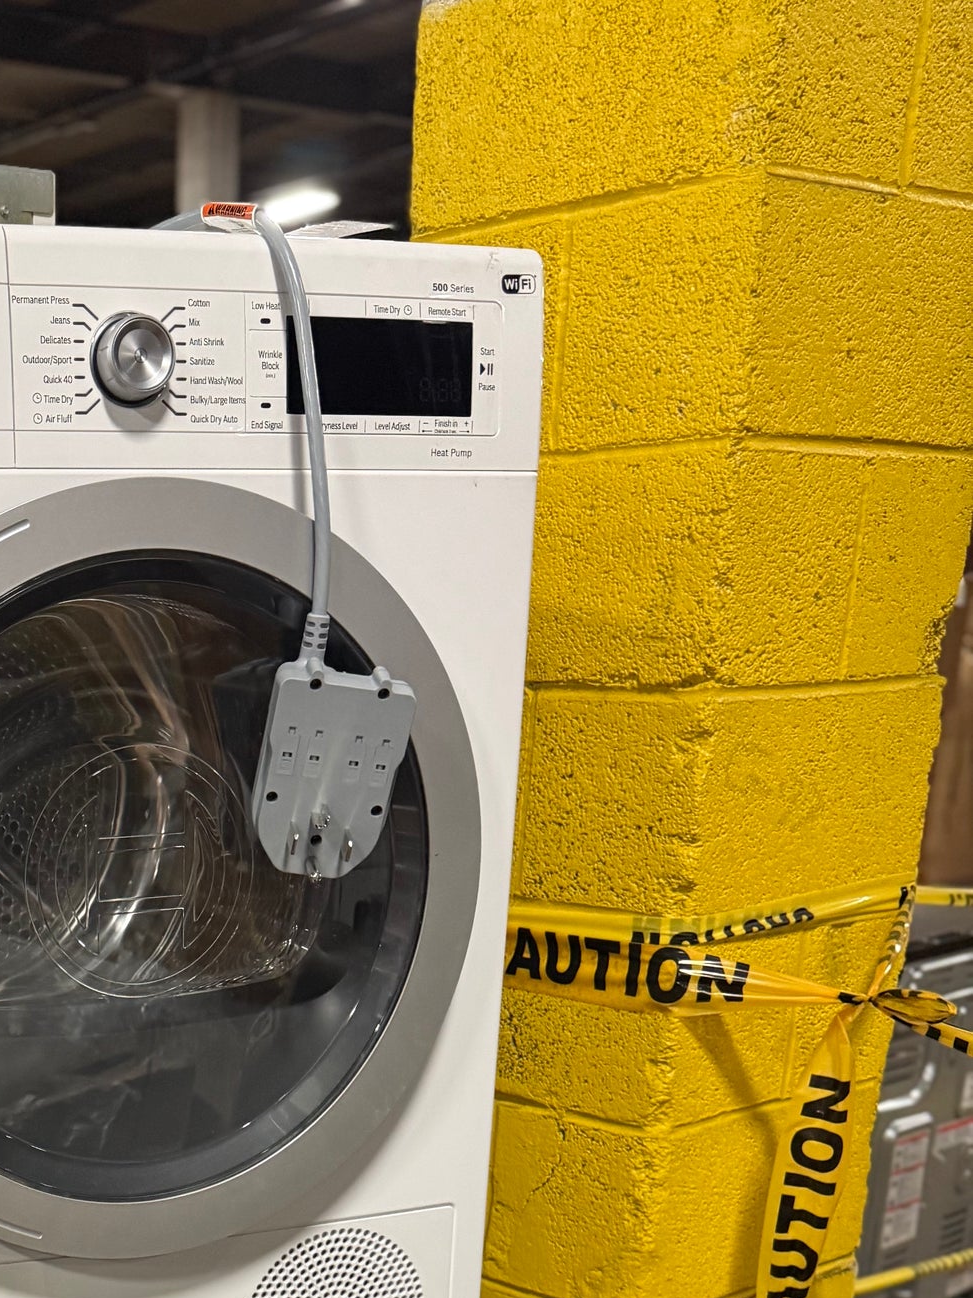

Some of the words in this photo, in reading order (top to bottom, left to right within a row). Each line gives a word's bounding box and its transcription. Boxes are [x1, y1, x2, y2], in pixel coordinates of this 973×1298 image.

[432, 283, 448, 292] 500
[450, 284, 474, 293] Series
[503, 276, 534, 292] WiFi
[11, 295, 49, 304] Permanent
[50, 296, 70, 304] Press
[188, 298, 210, 307] Cotton
[252, 301, 265, 310] Low
[265, 301, 281, 310] Heat
[374, 305, 388, 314] Time
[389, 305, 401, 315] Dry
[428, 307, 451, 316] Remote
[452, 308, 466, 316] Start
[50, 316, 71, 324] Jeans
[188, 317, 200, 326] Mix
[40, 335, 71, 344] Delicates
[189, 337, 202, 346] Anti
[203, 337, 224, 346] Shrink
[258, 350, 283, 359] Wrinkle
[480, 347, 495, 356] Start
[22, 355, 72, 365] Outdoor/Sport
[189, 357, 215, 365] Sanitize
[262, 361, 279, 370] Block
[43, 375, 62, 384] Quick
[63, 375, 73, 384] 40
[190, 376, 207, 385] Hand
[208, 376, 243, 386] Wash/Wool
[479, 383, 495, 391] Pause
[44, 395, 60, 403] Time
[61, 395, 74, 405] Dry
[190, 395, 228, 406] Bulky/Large
[229, 396, 246, 404] Items
[45, 414, 55, 423] Air
[57, 414, 72, 423] Fluff
[190, 414, 209, 423] Quick
[210, 415, 222, 425] Dry
[223, 415, 238, 423] Auto
[435, 419, 451, 427] Finish
[452, 419, 458, 427] in
[251, 421, 263, 429] End
[264, 421, 283, 430] Signal
[322, 422, 342, 432] ryness
[342, 422, 358, 430] Level
[374, 422, 390, 430] Level
[391, 421, 410, 432] Adjust
[431, 448, 448, 457] Heat
[450, 449, 472, 458] Pump
[506, 927, 750, 1003] AUTION
